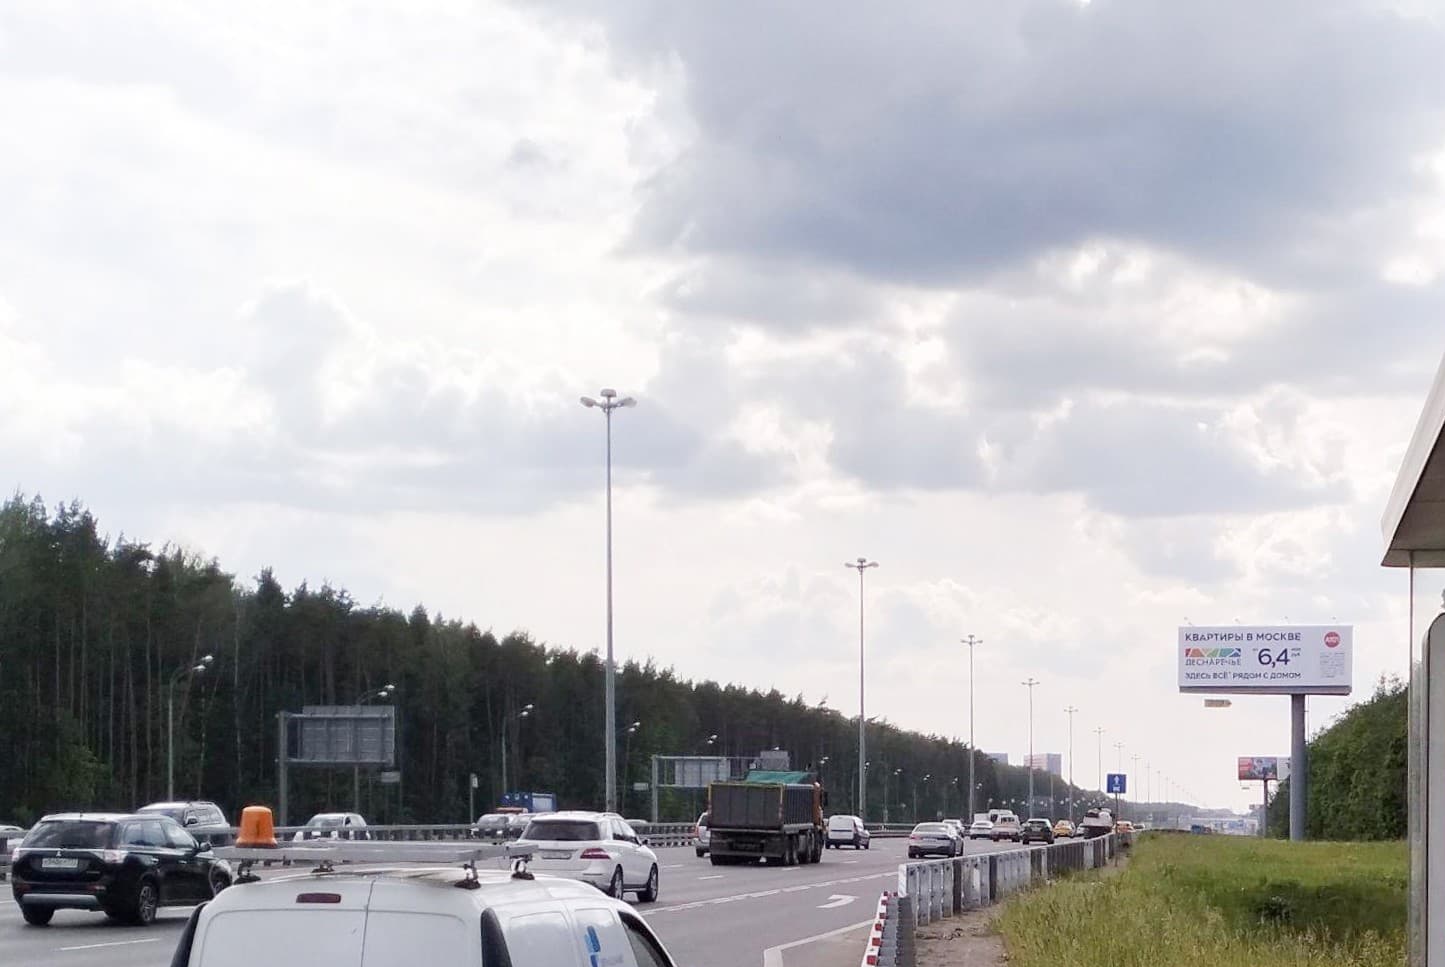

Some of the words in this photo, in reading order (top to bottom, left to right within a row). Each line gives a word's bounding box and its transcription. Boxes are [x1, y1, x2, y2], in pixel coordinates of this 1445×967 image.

[1185, 633, 1244, 641] КВАРТИРЫ
[1246, 633, 1253, 641] В
[1256, 632, 1302, 641] МОСКВЕ
[1257, 647, 1291, 669] 6,4
[1185, 672, 1211, 680] ЗДЕСЬ
[1232, 672, 1262, 680] РЯДОМ
[1263, 672, 1269, 680] С
[1270, 672, 1302, 680] ДОМОМ
